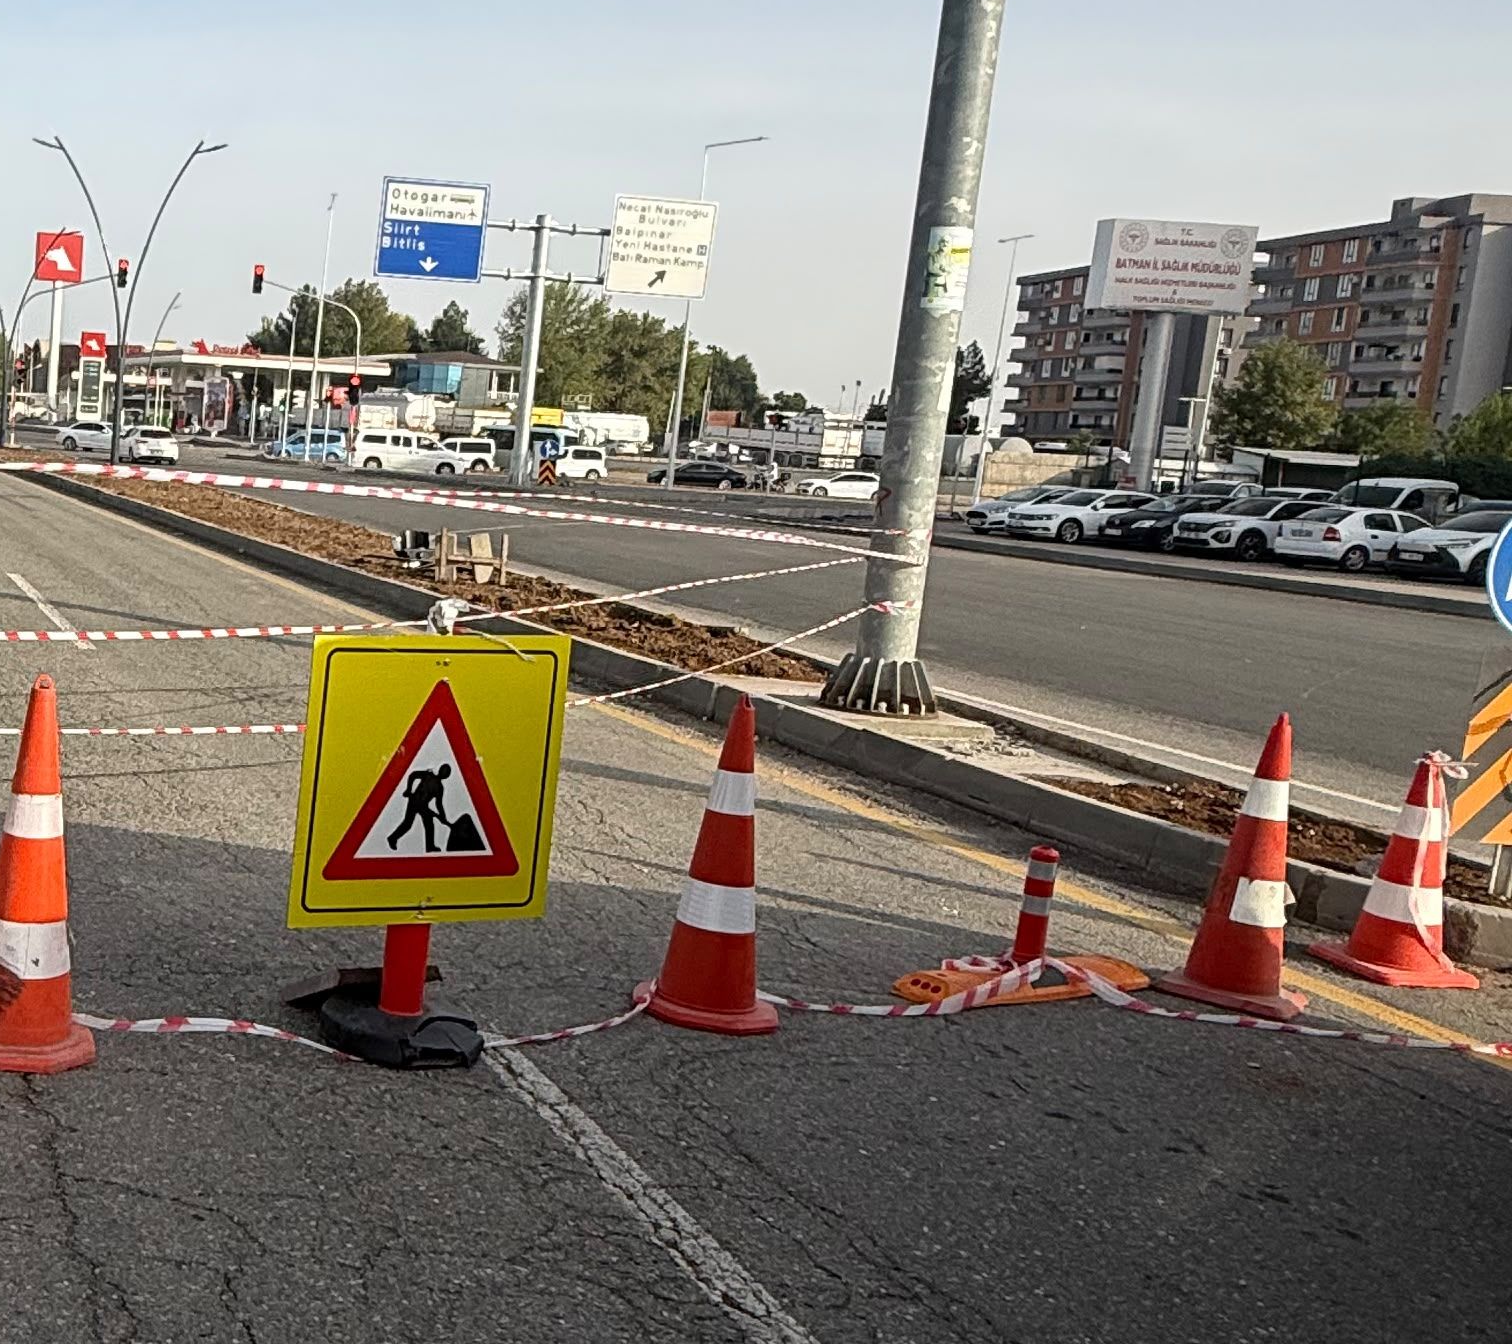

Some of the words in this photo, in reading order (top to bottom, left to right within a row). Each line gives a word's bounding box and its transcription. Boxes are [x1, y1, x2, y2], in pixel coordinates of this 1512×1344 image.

[392, 188, 447, 204] Otogar
[390, 203, 466, 219] Havalimanı
[383, 221, 420, 236] Siirt
[382, 236, 426, 251] Bitlis
[615, 239, 640, 247] Yeni
[644, 241, 693, 254] Hastane
